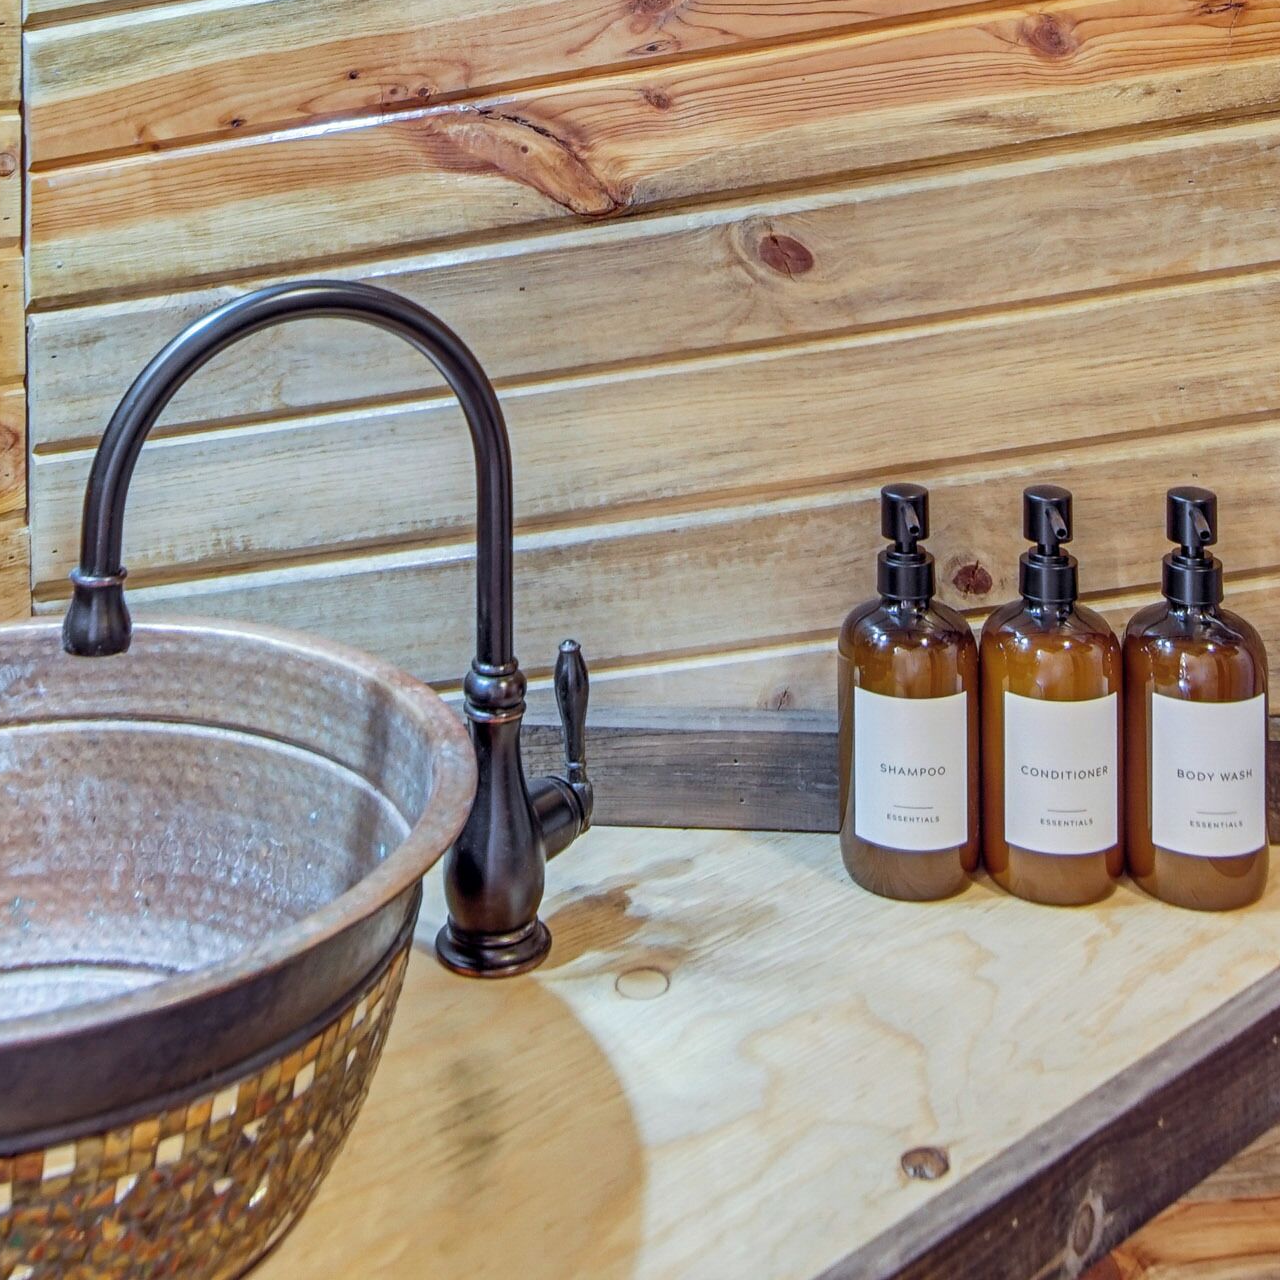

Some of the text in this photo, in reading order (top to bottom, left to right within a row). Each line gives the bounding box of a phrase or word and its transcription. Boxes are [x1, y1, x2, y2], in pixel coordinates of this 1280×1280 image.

[880, 763, 946, 777] SHAMPOO
[1020, 765, 1109, 781] CONDITIONER
[1176, 768, 1253, 783] BODY WASH
[886, 813, 940, 823] ESSENTIALS
[1040, 817, 1094, 827] ESSENTIALS
[1189, 820, 1244, 830] ESSENTIALS
